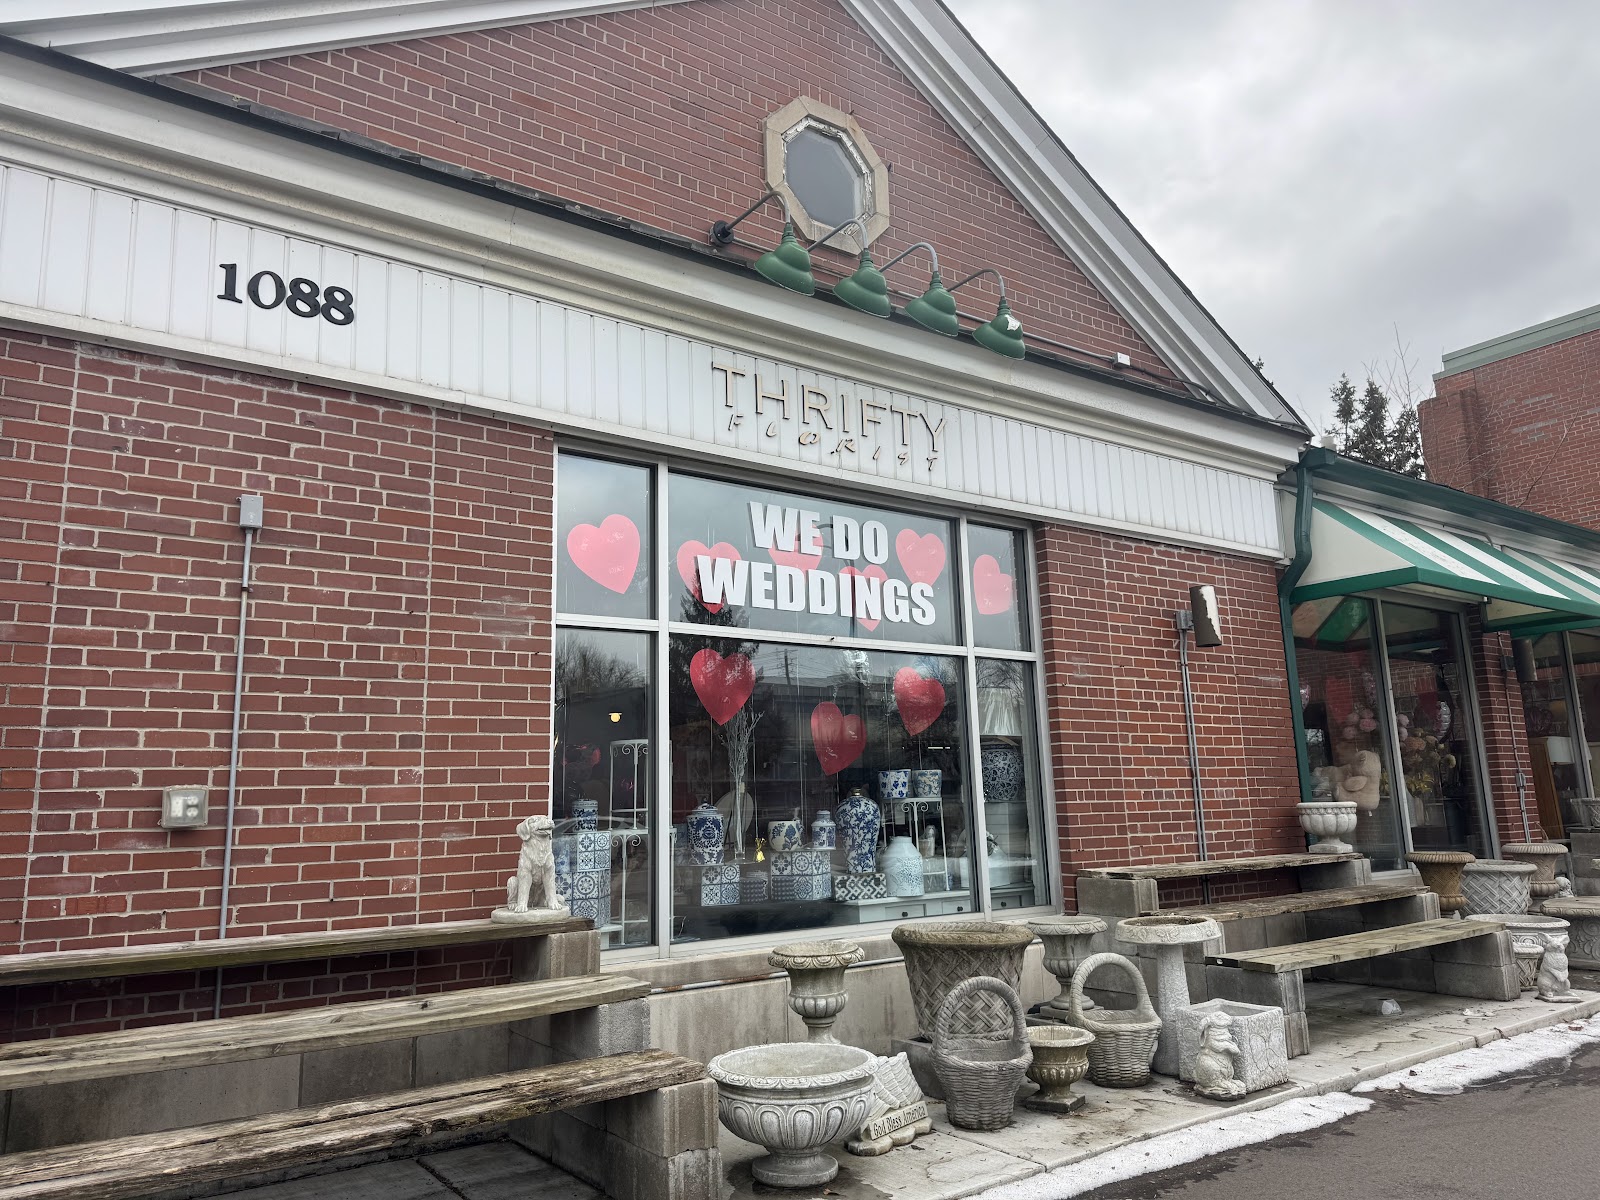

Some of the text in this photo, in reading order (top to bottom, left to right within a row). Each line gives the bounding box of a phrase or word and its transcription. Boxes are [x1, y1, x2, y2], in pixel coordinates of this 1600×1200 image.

[217, 263, 355, 325] 1088
[711, 361, 947, 452] THRIFTY
[728, 413, 938, 471] FLORIST
[748, 501, 889, 565] WE DO
[697, 555, 936, 625] WEDDINGS
[873, 1105, 926, 1138] God Bless America
